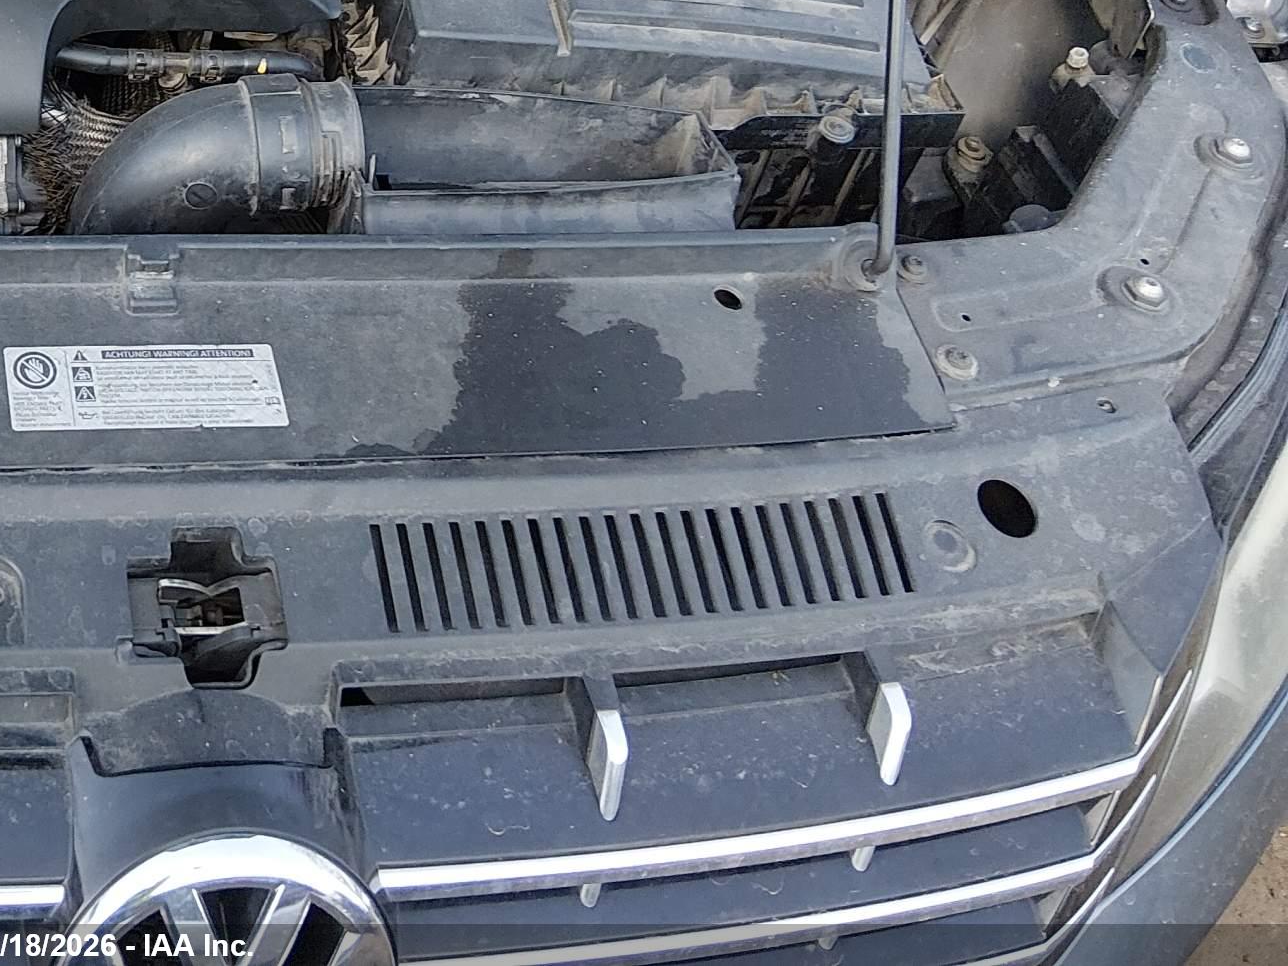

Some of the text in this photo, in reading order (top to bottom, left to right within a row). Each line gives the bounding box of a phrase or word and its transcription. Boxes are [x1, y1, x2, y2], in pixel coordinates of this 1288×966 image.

[104, 349, 251, 358] ACHTUNG! WARNING! ATTENTION!
